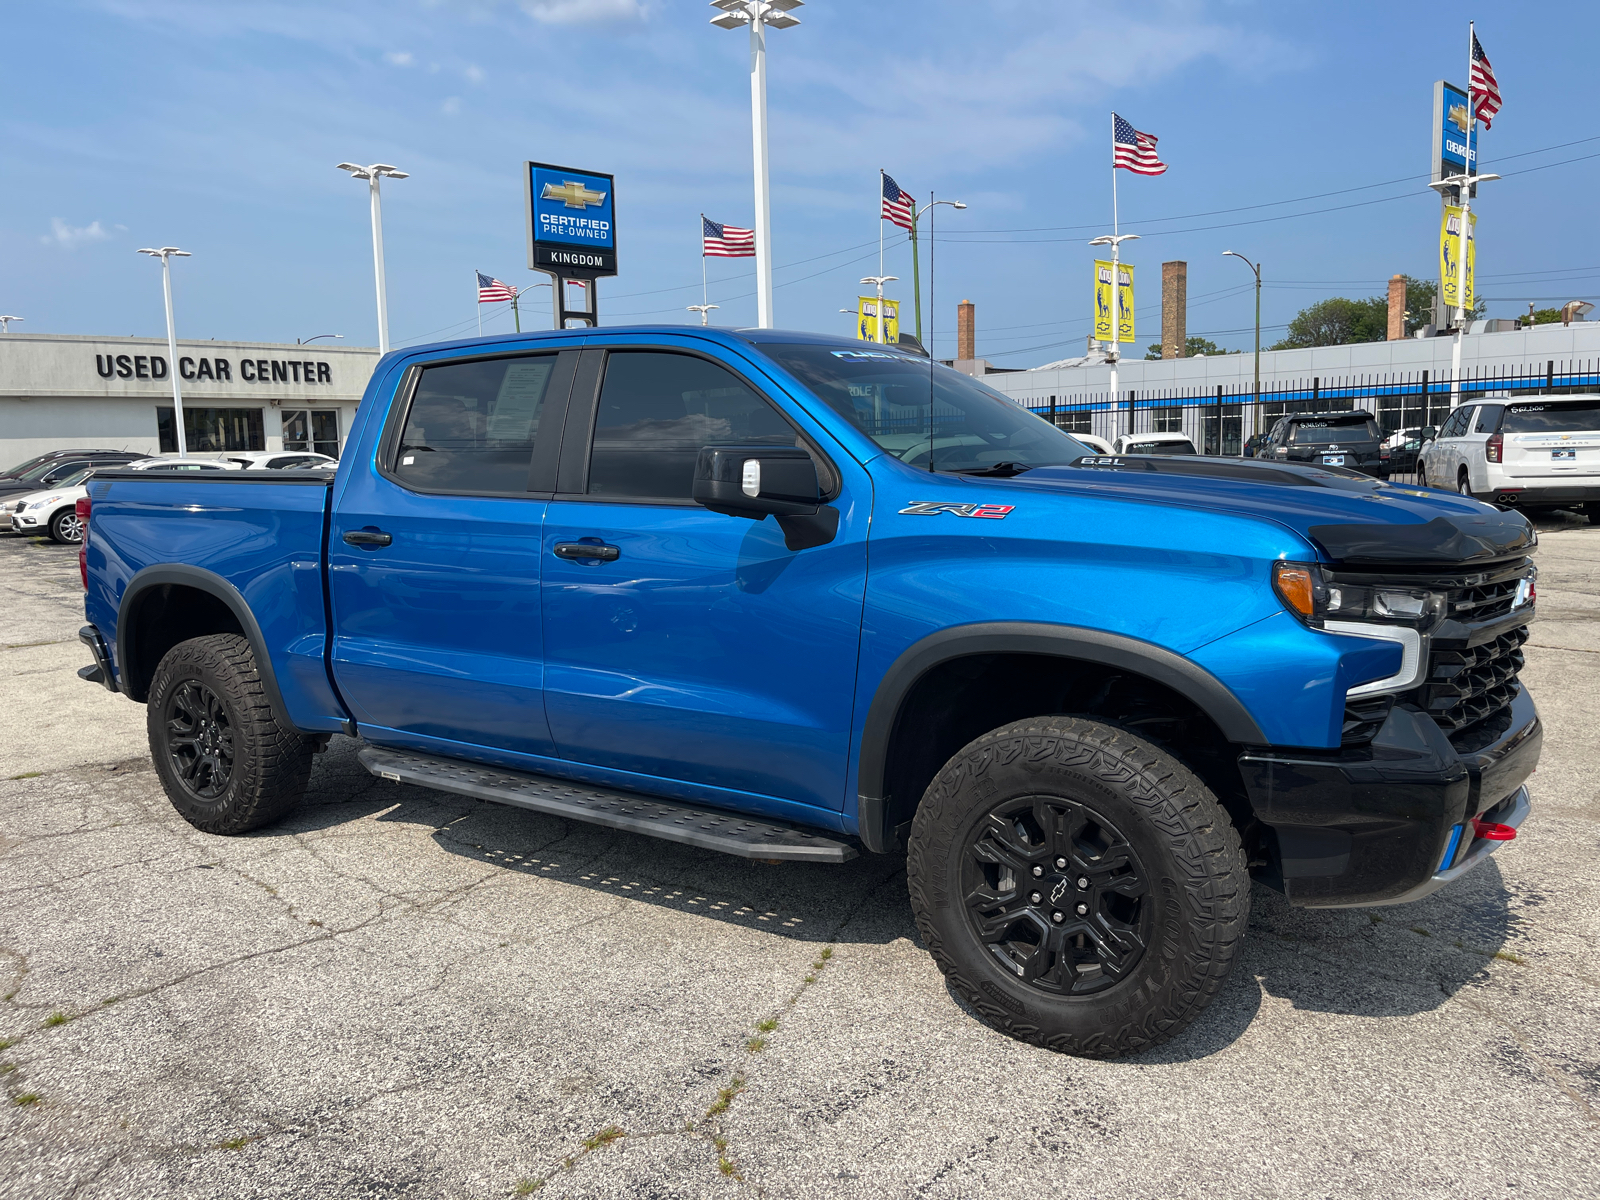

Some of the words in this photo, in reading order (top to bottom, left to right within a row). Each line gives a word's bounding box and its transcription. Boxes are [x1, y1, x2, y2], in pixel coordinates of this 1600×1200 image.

[540, 213, 609, 230] CERTIFIED
[543, 224, 607, 239] PRE-OWNED
[551, 251, 603, 266] KINGDOM
[96, 354, 167, 379] USED
[179, 356, 231, 381] CAR
[240, 358, 332, 383] CENTER
[1080, 457, 1126, 467] 6.2L
[898, 500, 1017, 521] ZR2
[934, 776, 999, 909] WRANGLER
